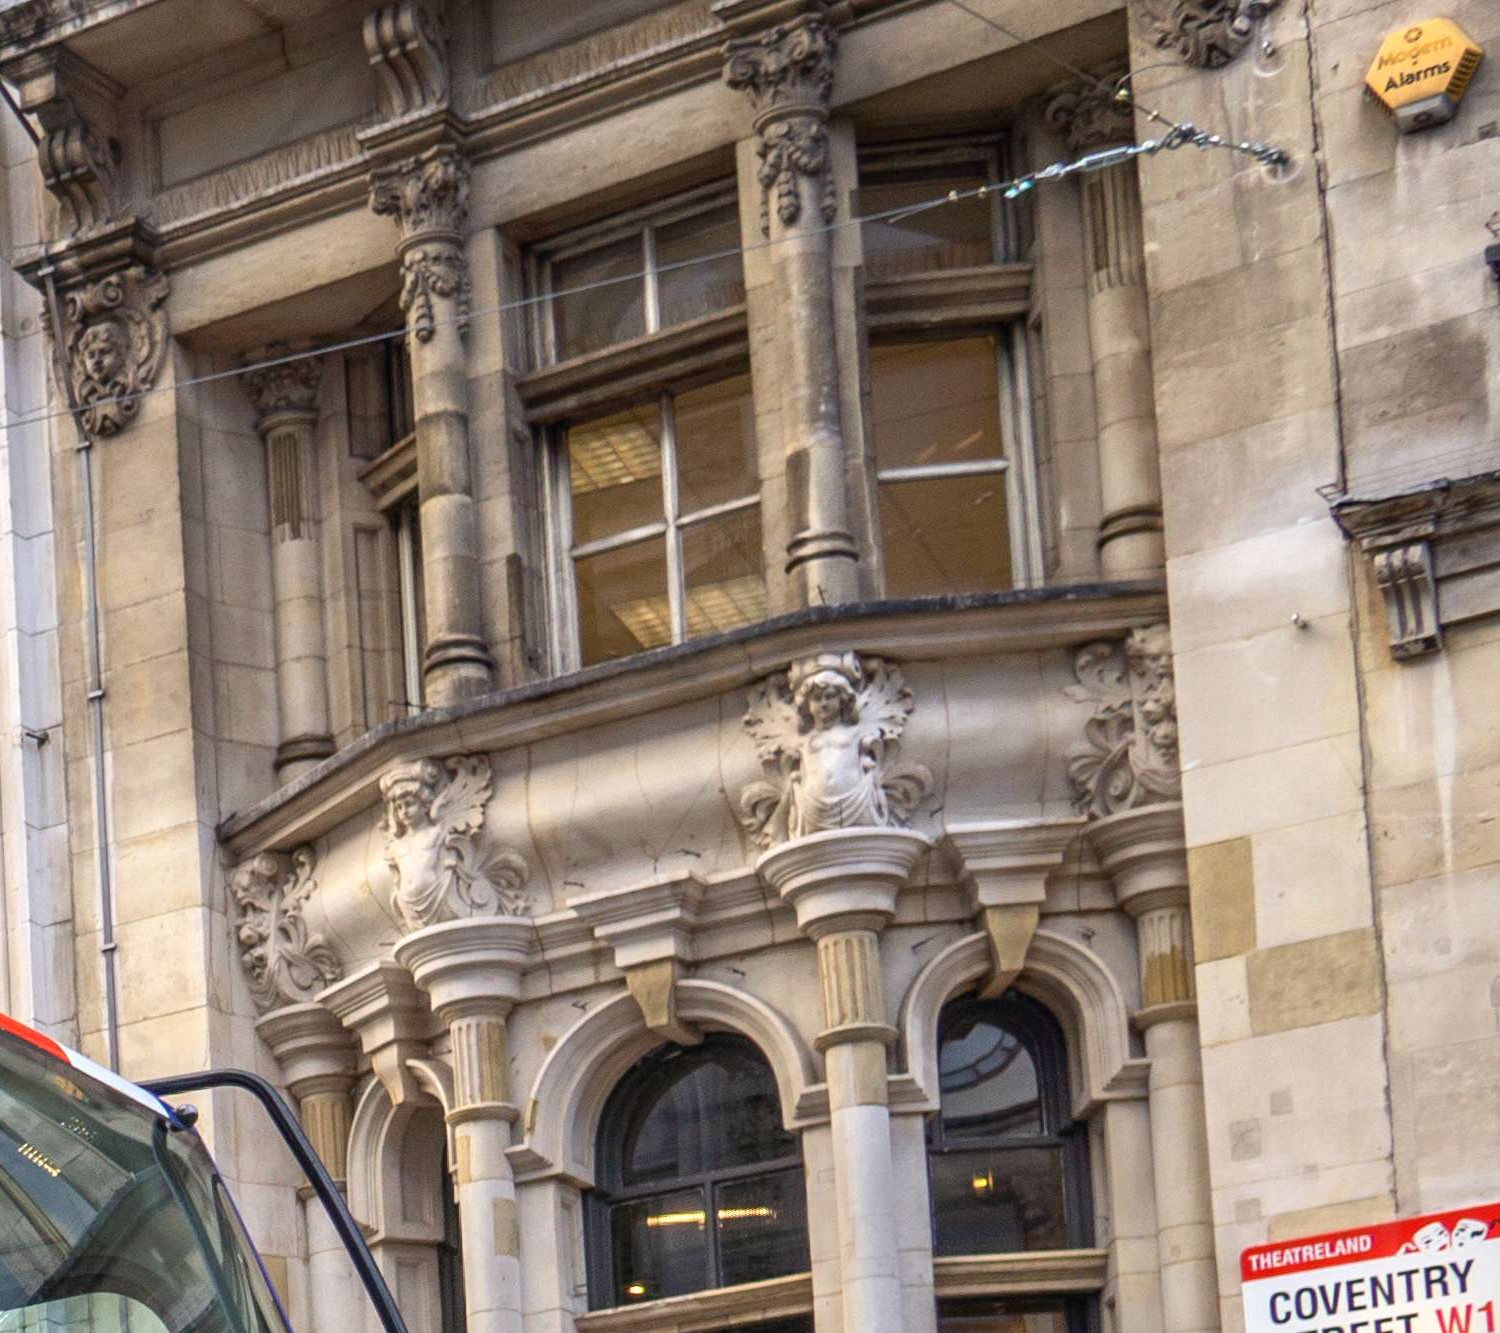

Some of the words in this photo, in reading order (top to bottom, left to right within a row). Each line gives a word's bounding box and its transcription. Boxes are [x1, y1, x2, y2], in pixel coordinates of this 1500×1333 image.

[1384, 60, 1451, 93] Alarms
[1248, 1235, 1372, 1272] THEATRELAND
[1269, 1258, 1475, 1325] COVENTRY
